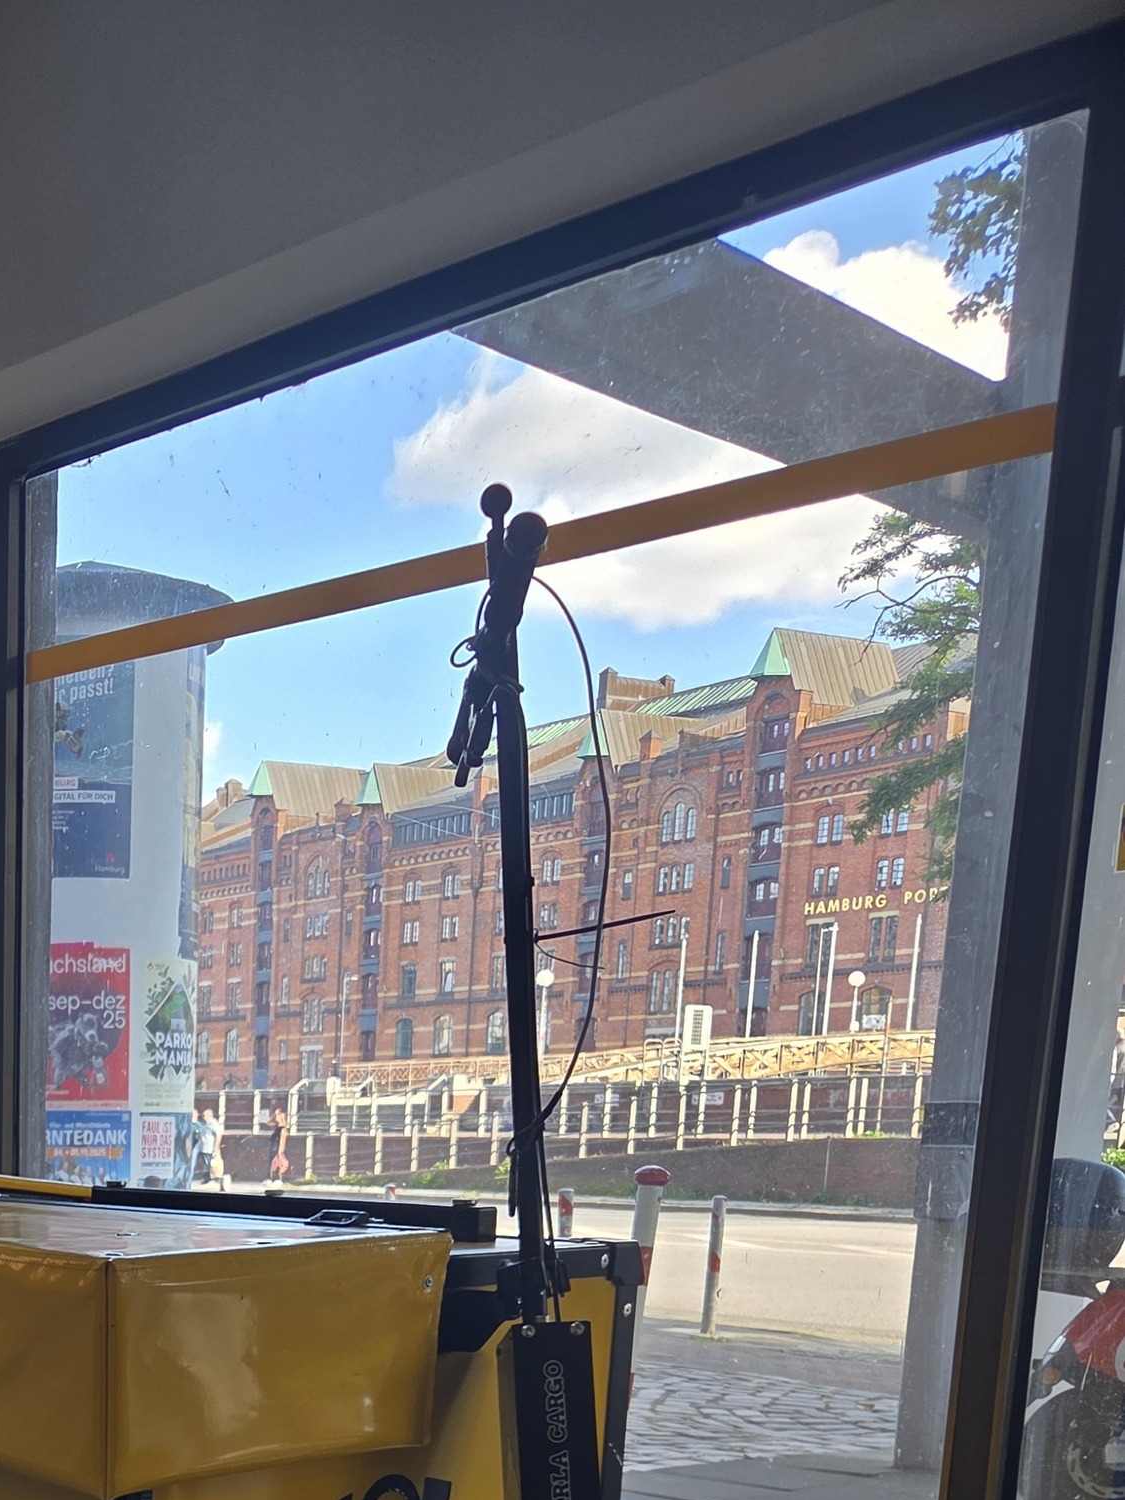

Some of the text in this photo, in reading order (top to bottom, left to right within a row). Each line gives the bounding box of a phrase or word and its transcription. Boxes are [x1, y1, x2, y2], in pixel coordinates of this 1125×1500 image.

[69, 677, 115, 704] passt!
[94, 792, 114, 800] DICH
[804, 894, 888, 915] HAMBURG
[103, 1010, 126, 1029] 25
[155, 1031, 193, 1050] PARKO
[141, 1120, 173, 1134] FAUL IST
[141, 1134, 172, 1147] NUR DAS
[140, 1147, 172, 1159] SYSTEM
[543, 1360, 568, 1443] CARGO
